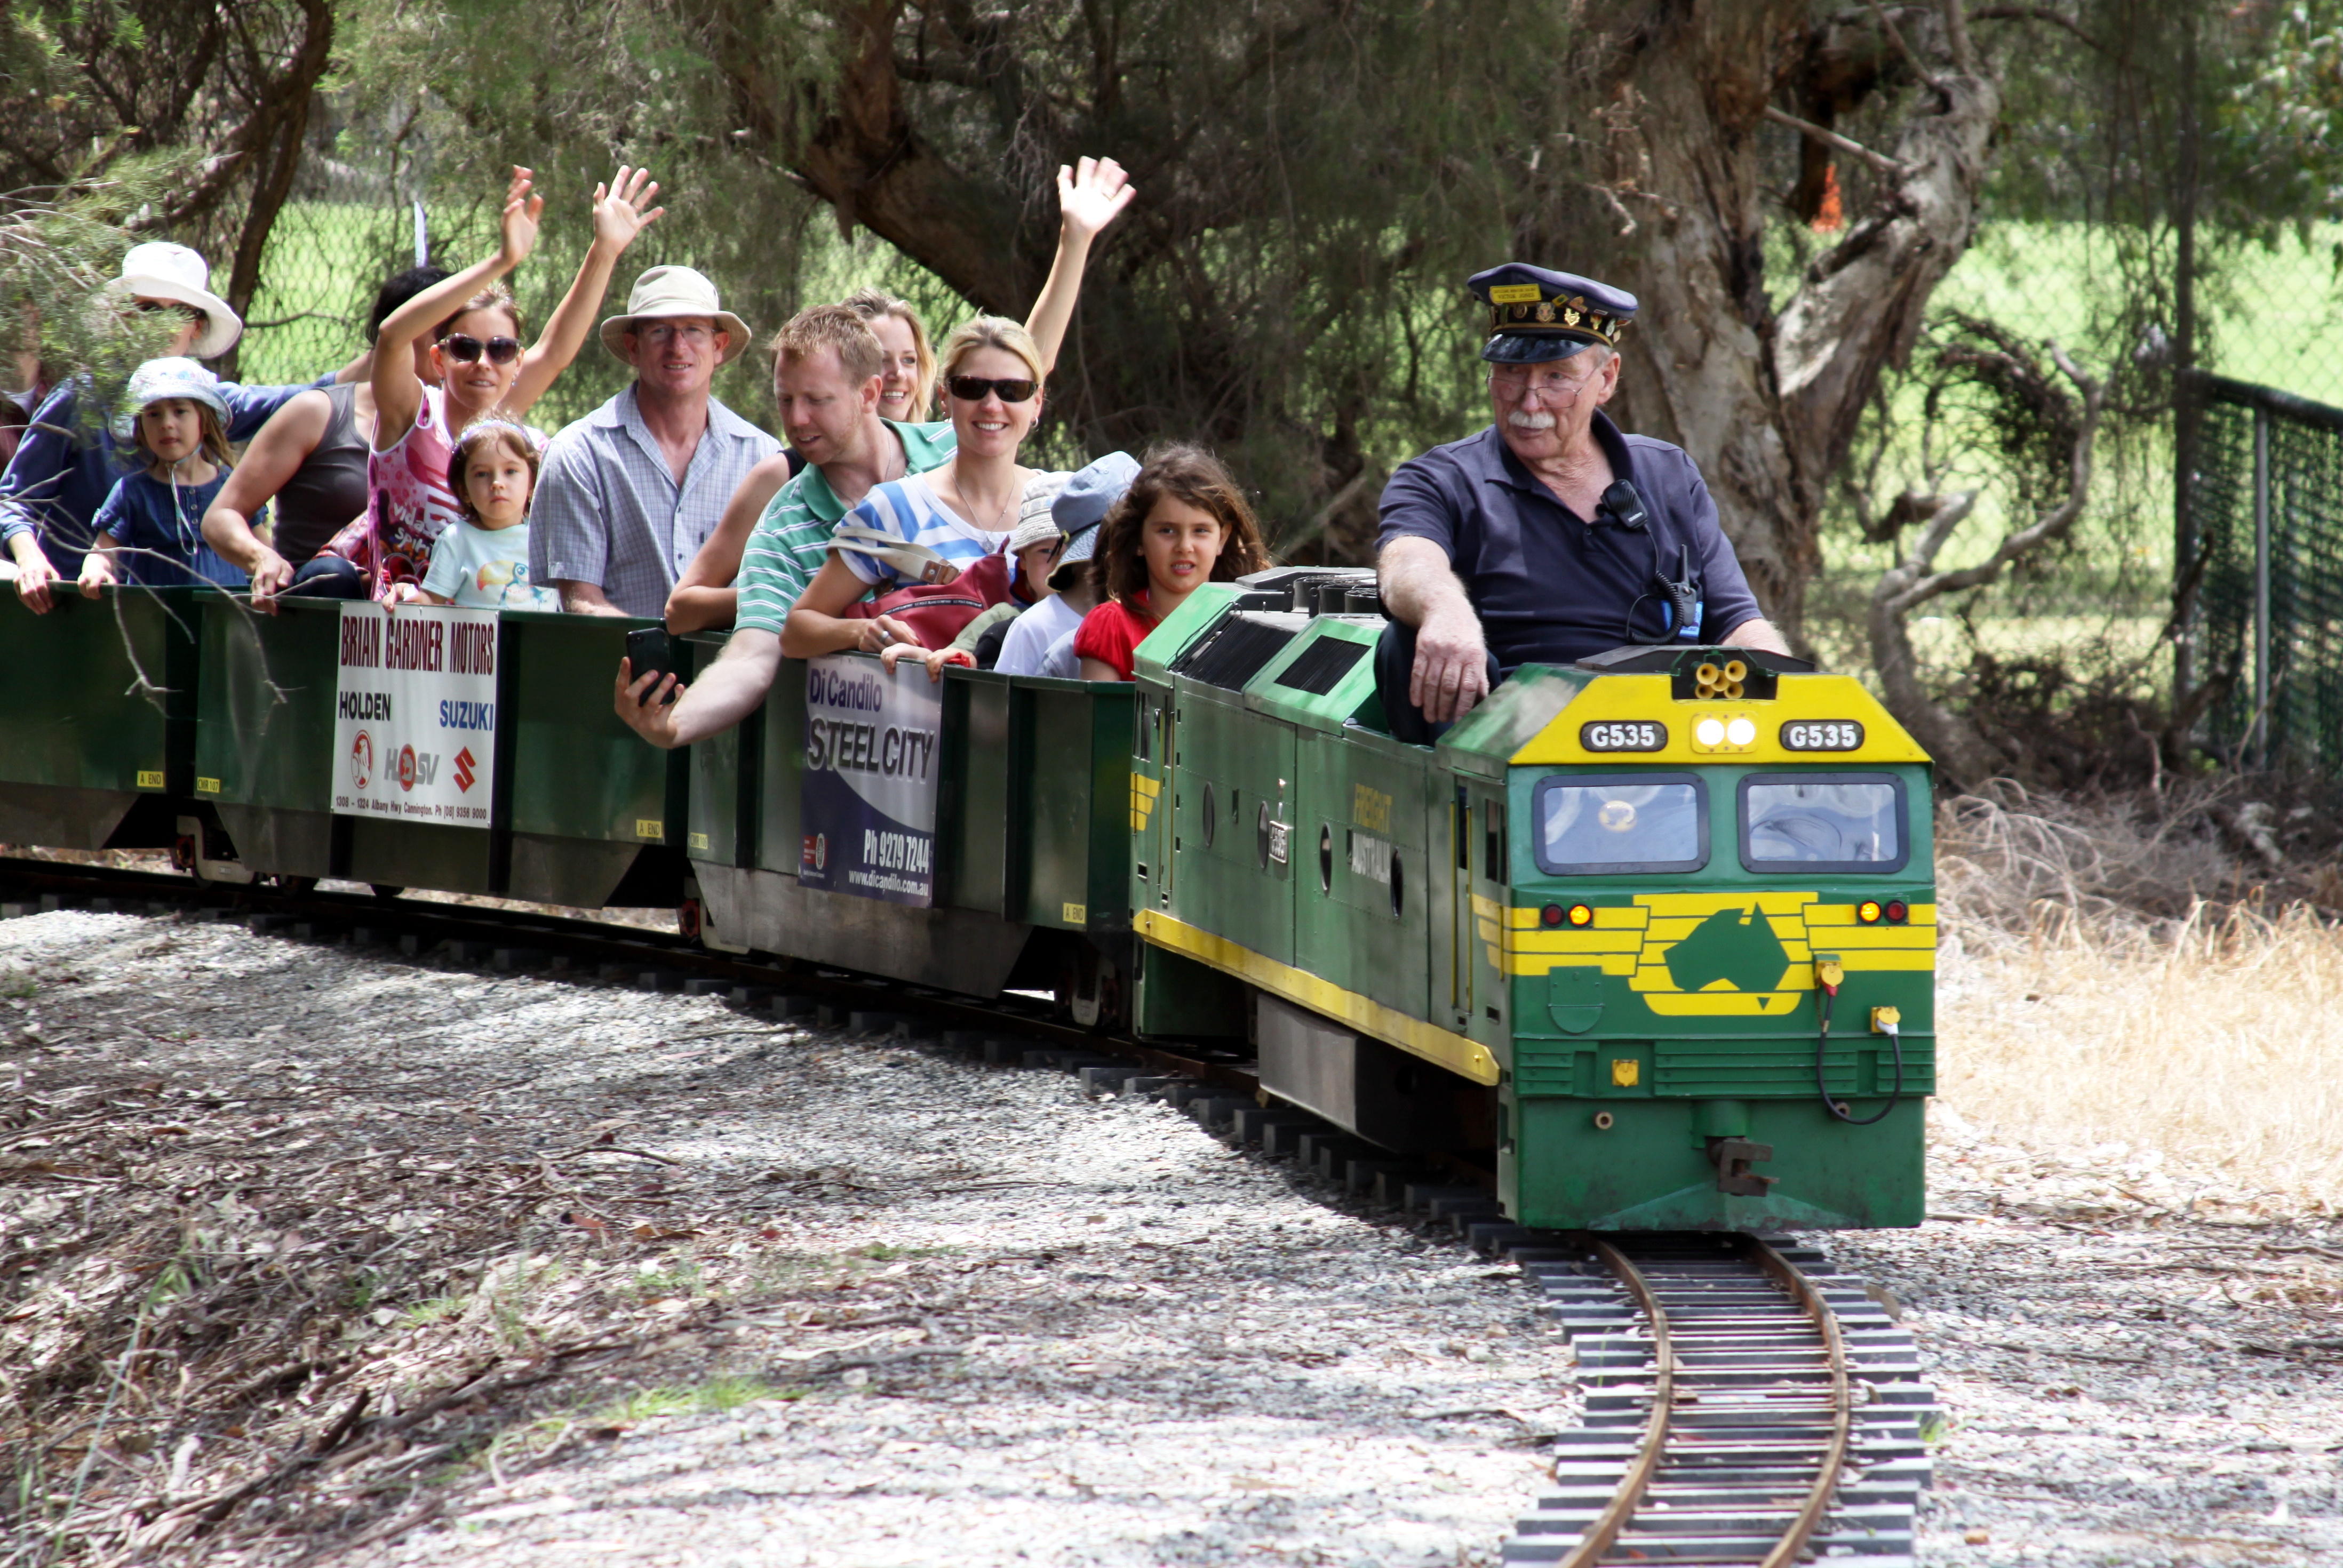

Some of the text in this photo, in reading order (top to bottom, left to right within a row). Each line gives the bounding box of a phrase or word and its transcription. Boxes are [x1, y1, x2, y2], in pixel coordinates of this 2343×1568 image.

[340, 615, 494, 676] BRIAN GARDNER MOTORS
[809, 667, 882, 712] Di Candilo
[339, 691, 391, 721] HOLDEN
[439, 699, 493, 731] SUZUKI
[807, 715, 935, 783] STEEL CITY
[1591, 724, 1655, 747] G535
[1790, 724, 1856, 747] G535
[140, 773, 161, 785] A END
[336, 795, 349, 807] 1308
[357, 797, 369, 809] 1324
[371, 798, 388, 814] Albany
[390, 800, 402, 814] Hwy
[435, 804, 442, 816] Ph
[456, 806, 469, 818] 9356
[472, 807, 487, 819] 9000
[639, 822, 660, 835] A END
[863, 828, 930, 874] Ph 9279 7244
[849, 869, 929, 897] www.dicandilo.com.au
[1065, 906, 1070, 919] A
